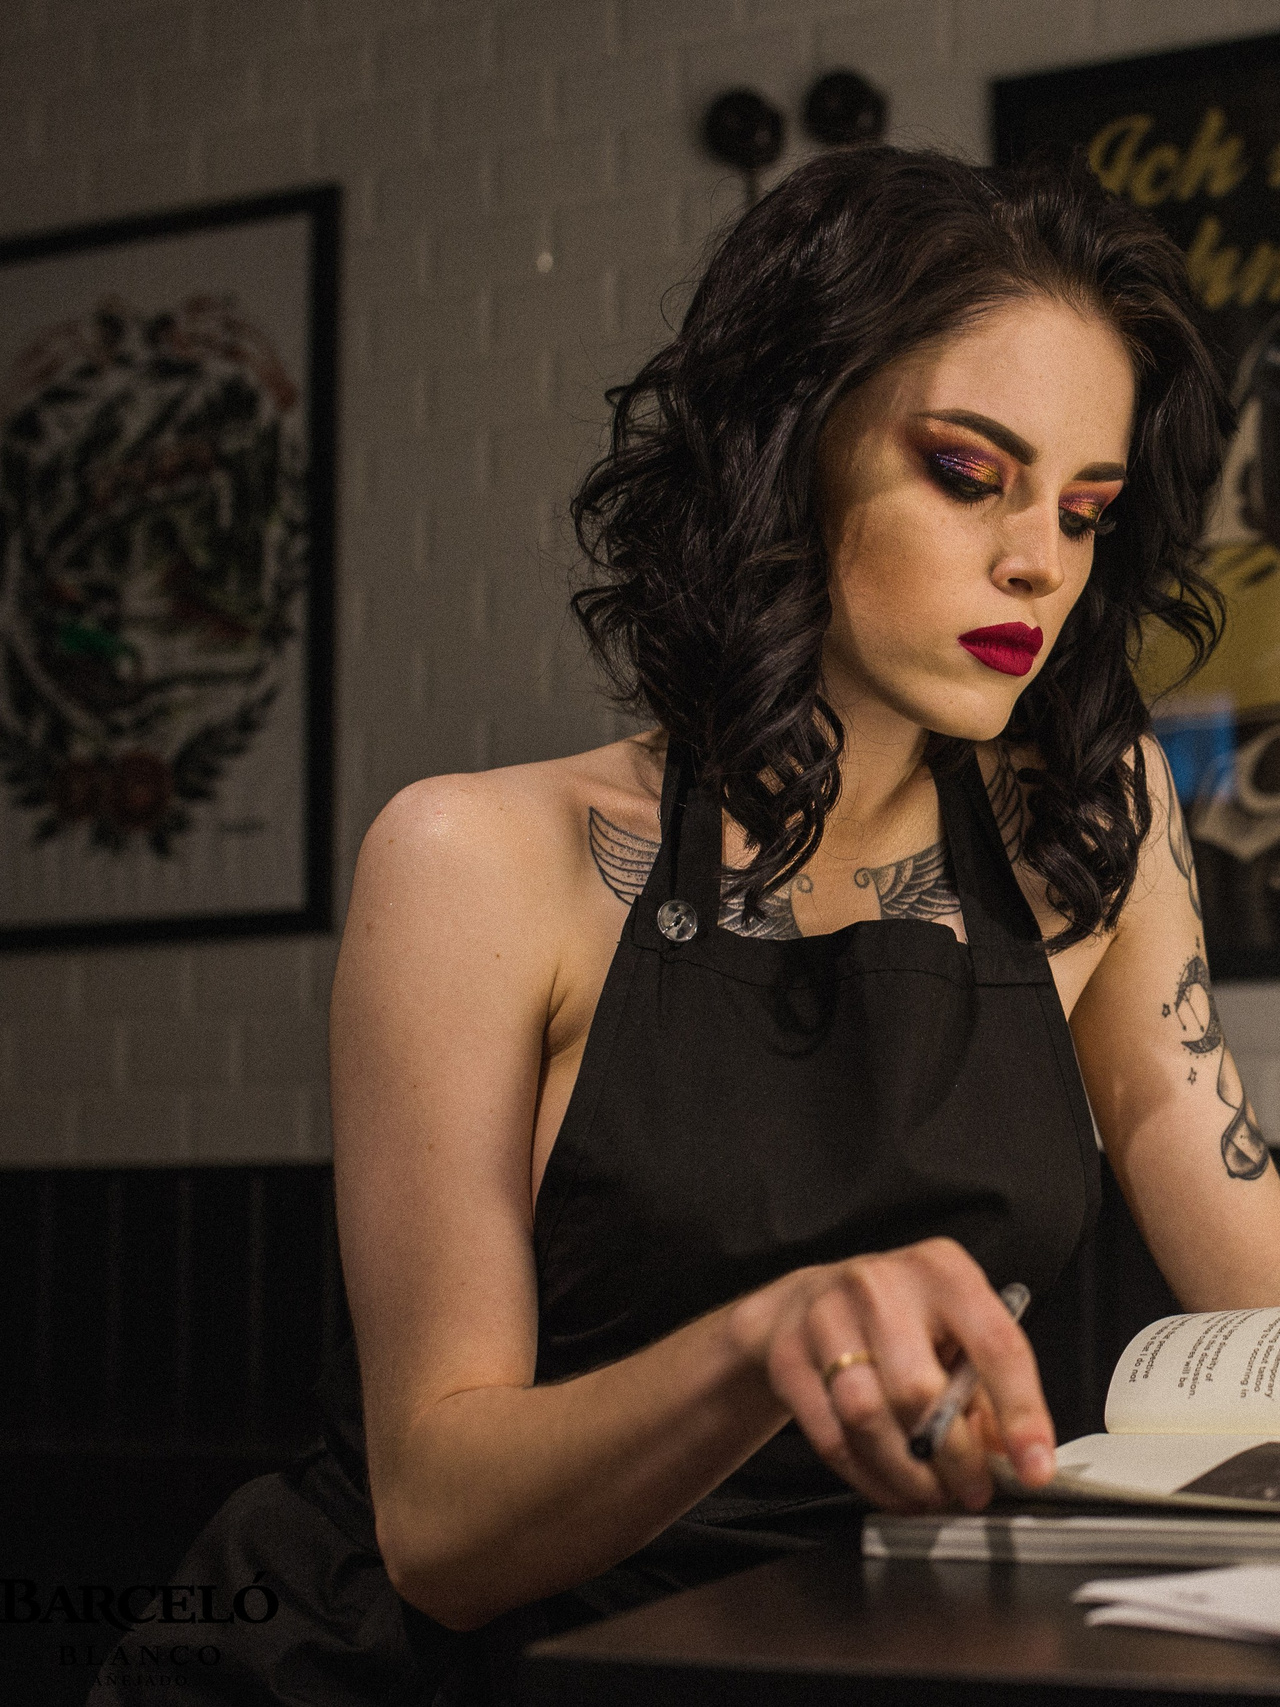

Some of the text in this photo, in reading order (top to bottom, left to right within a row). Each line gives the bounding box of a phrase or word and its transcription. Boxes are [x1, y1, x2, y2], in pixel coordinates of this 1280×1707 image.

[1088, 107, 1248, 206] Ich
[1141, 1340, 1156, 1353] that
[1260, 1344, 1276, 1365] about
[1133, 1357, 1145, 1368] do
[1142, 1340, 1167, 1380] perspective
[1205, 1341, 1228, 1371] diversity
[1180, 1360, 1193, 1375] will
[1187, 1351, 1210, 1401] discussion.
[1239, 1347, 1261, 1387] occurring
[1128, 1369, 1140, 1384] not
[1177, 1376, 1190, 1389] be
[1203, 1372, 1214, 1382] of
[1253, 1365, 1268, 1393] tattoo
[1239, 1388, 1251, 1400] in
